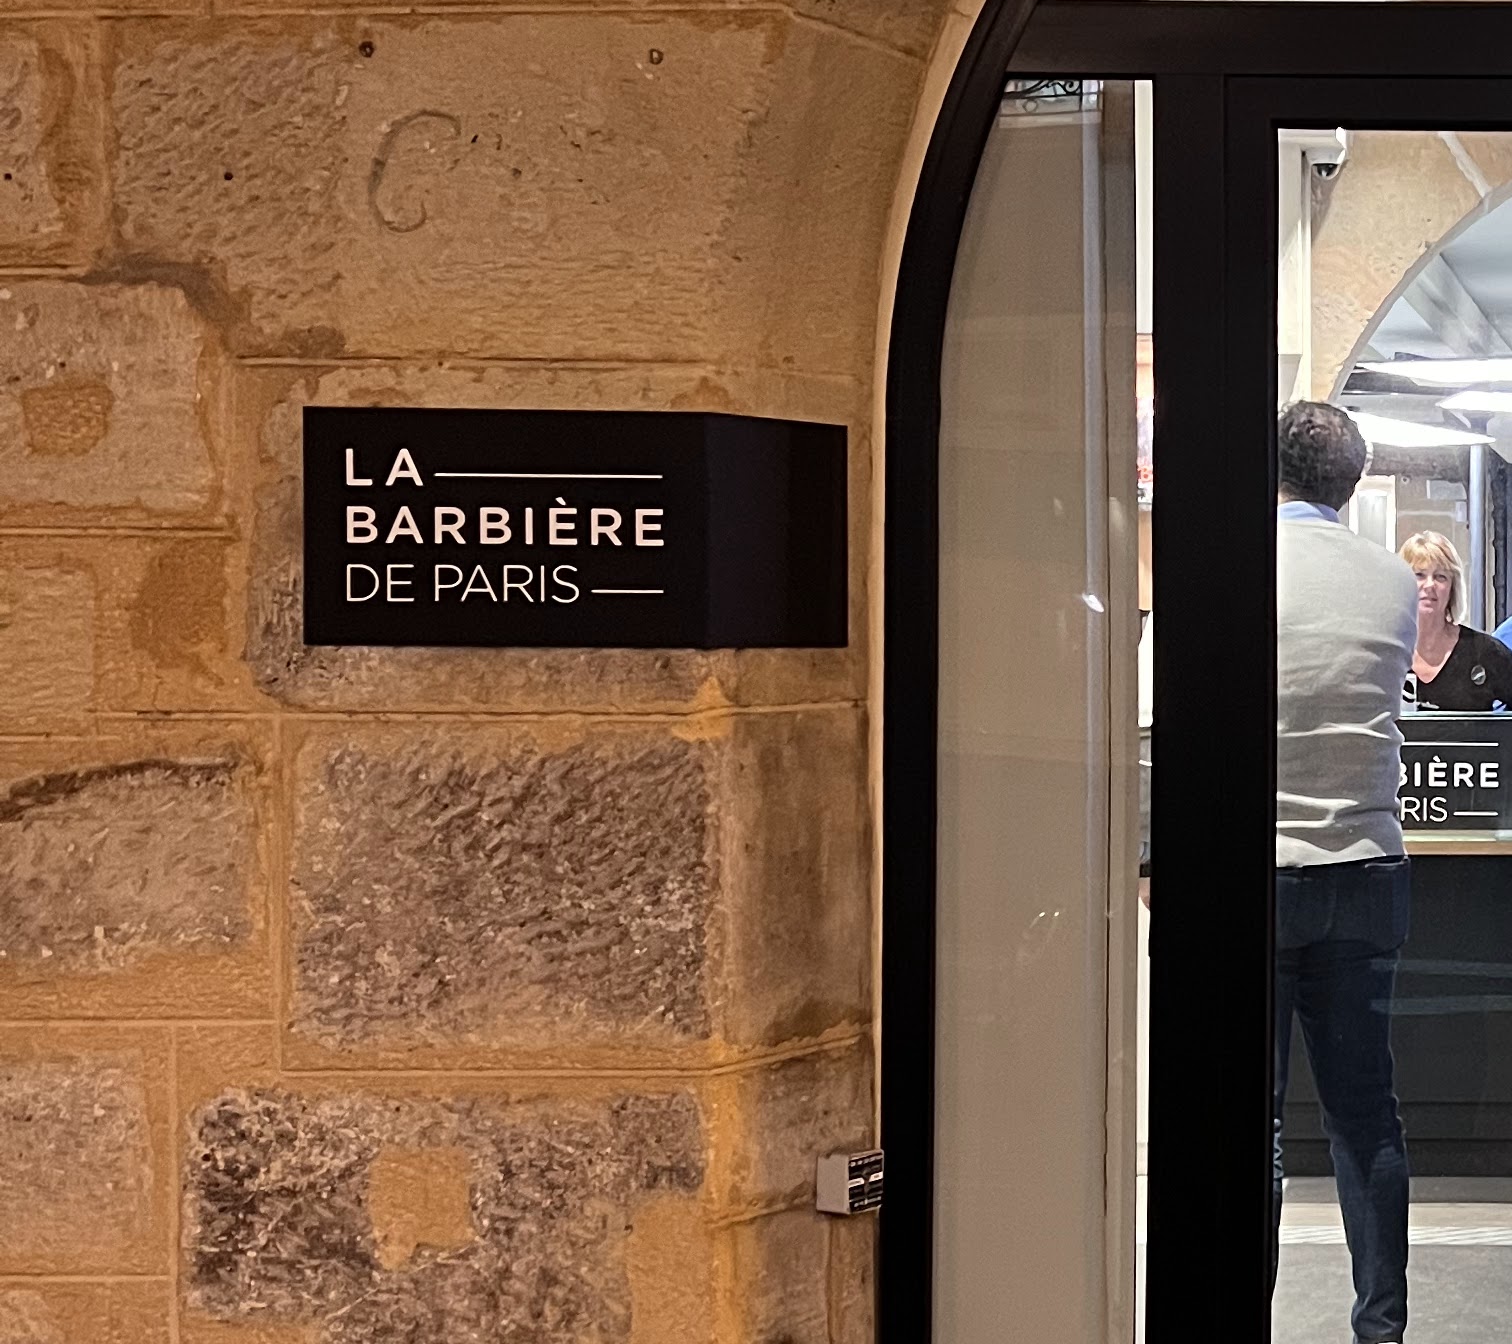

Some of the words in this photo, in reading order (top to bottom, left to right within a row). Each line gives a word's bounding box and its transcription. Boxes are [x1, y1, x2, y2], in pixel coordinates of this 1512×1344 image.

[345, 448, 424, 487] LA
[346, 497, 665, 547] BARBIÈRE
[346, 563, 415, 602] DE
[434, 563, 580, 603] PARIS
